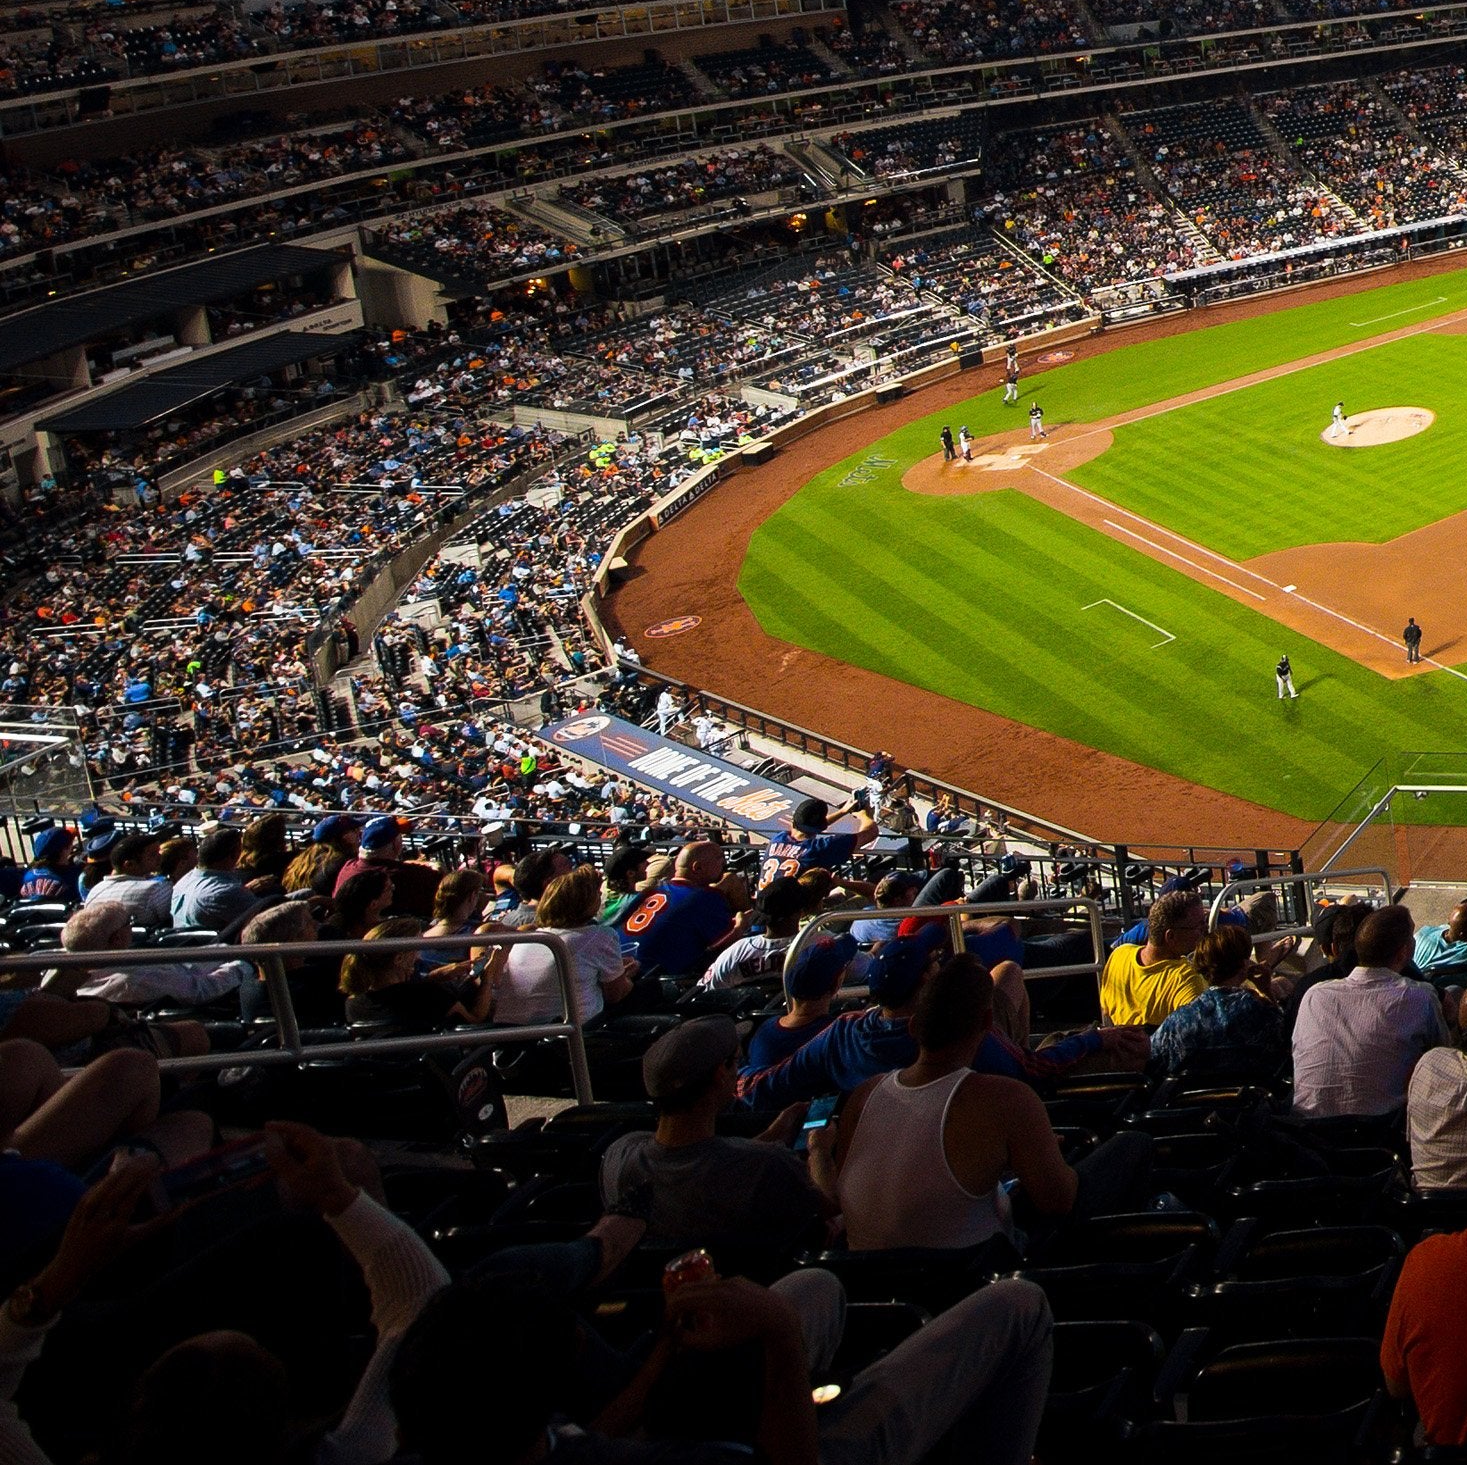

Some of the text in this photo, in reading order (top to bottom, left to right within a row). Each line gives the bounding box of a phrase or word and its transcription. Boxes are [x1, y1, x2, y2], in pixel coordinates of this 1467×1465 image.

[695, 472, 717, 495] DELTA
[663, 494, 688, 519] DELTA
[627, 746, 793, 822] HOME OF THE Mets
[626, 893, 667, 932] 8
